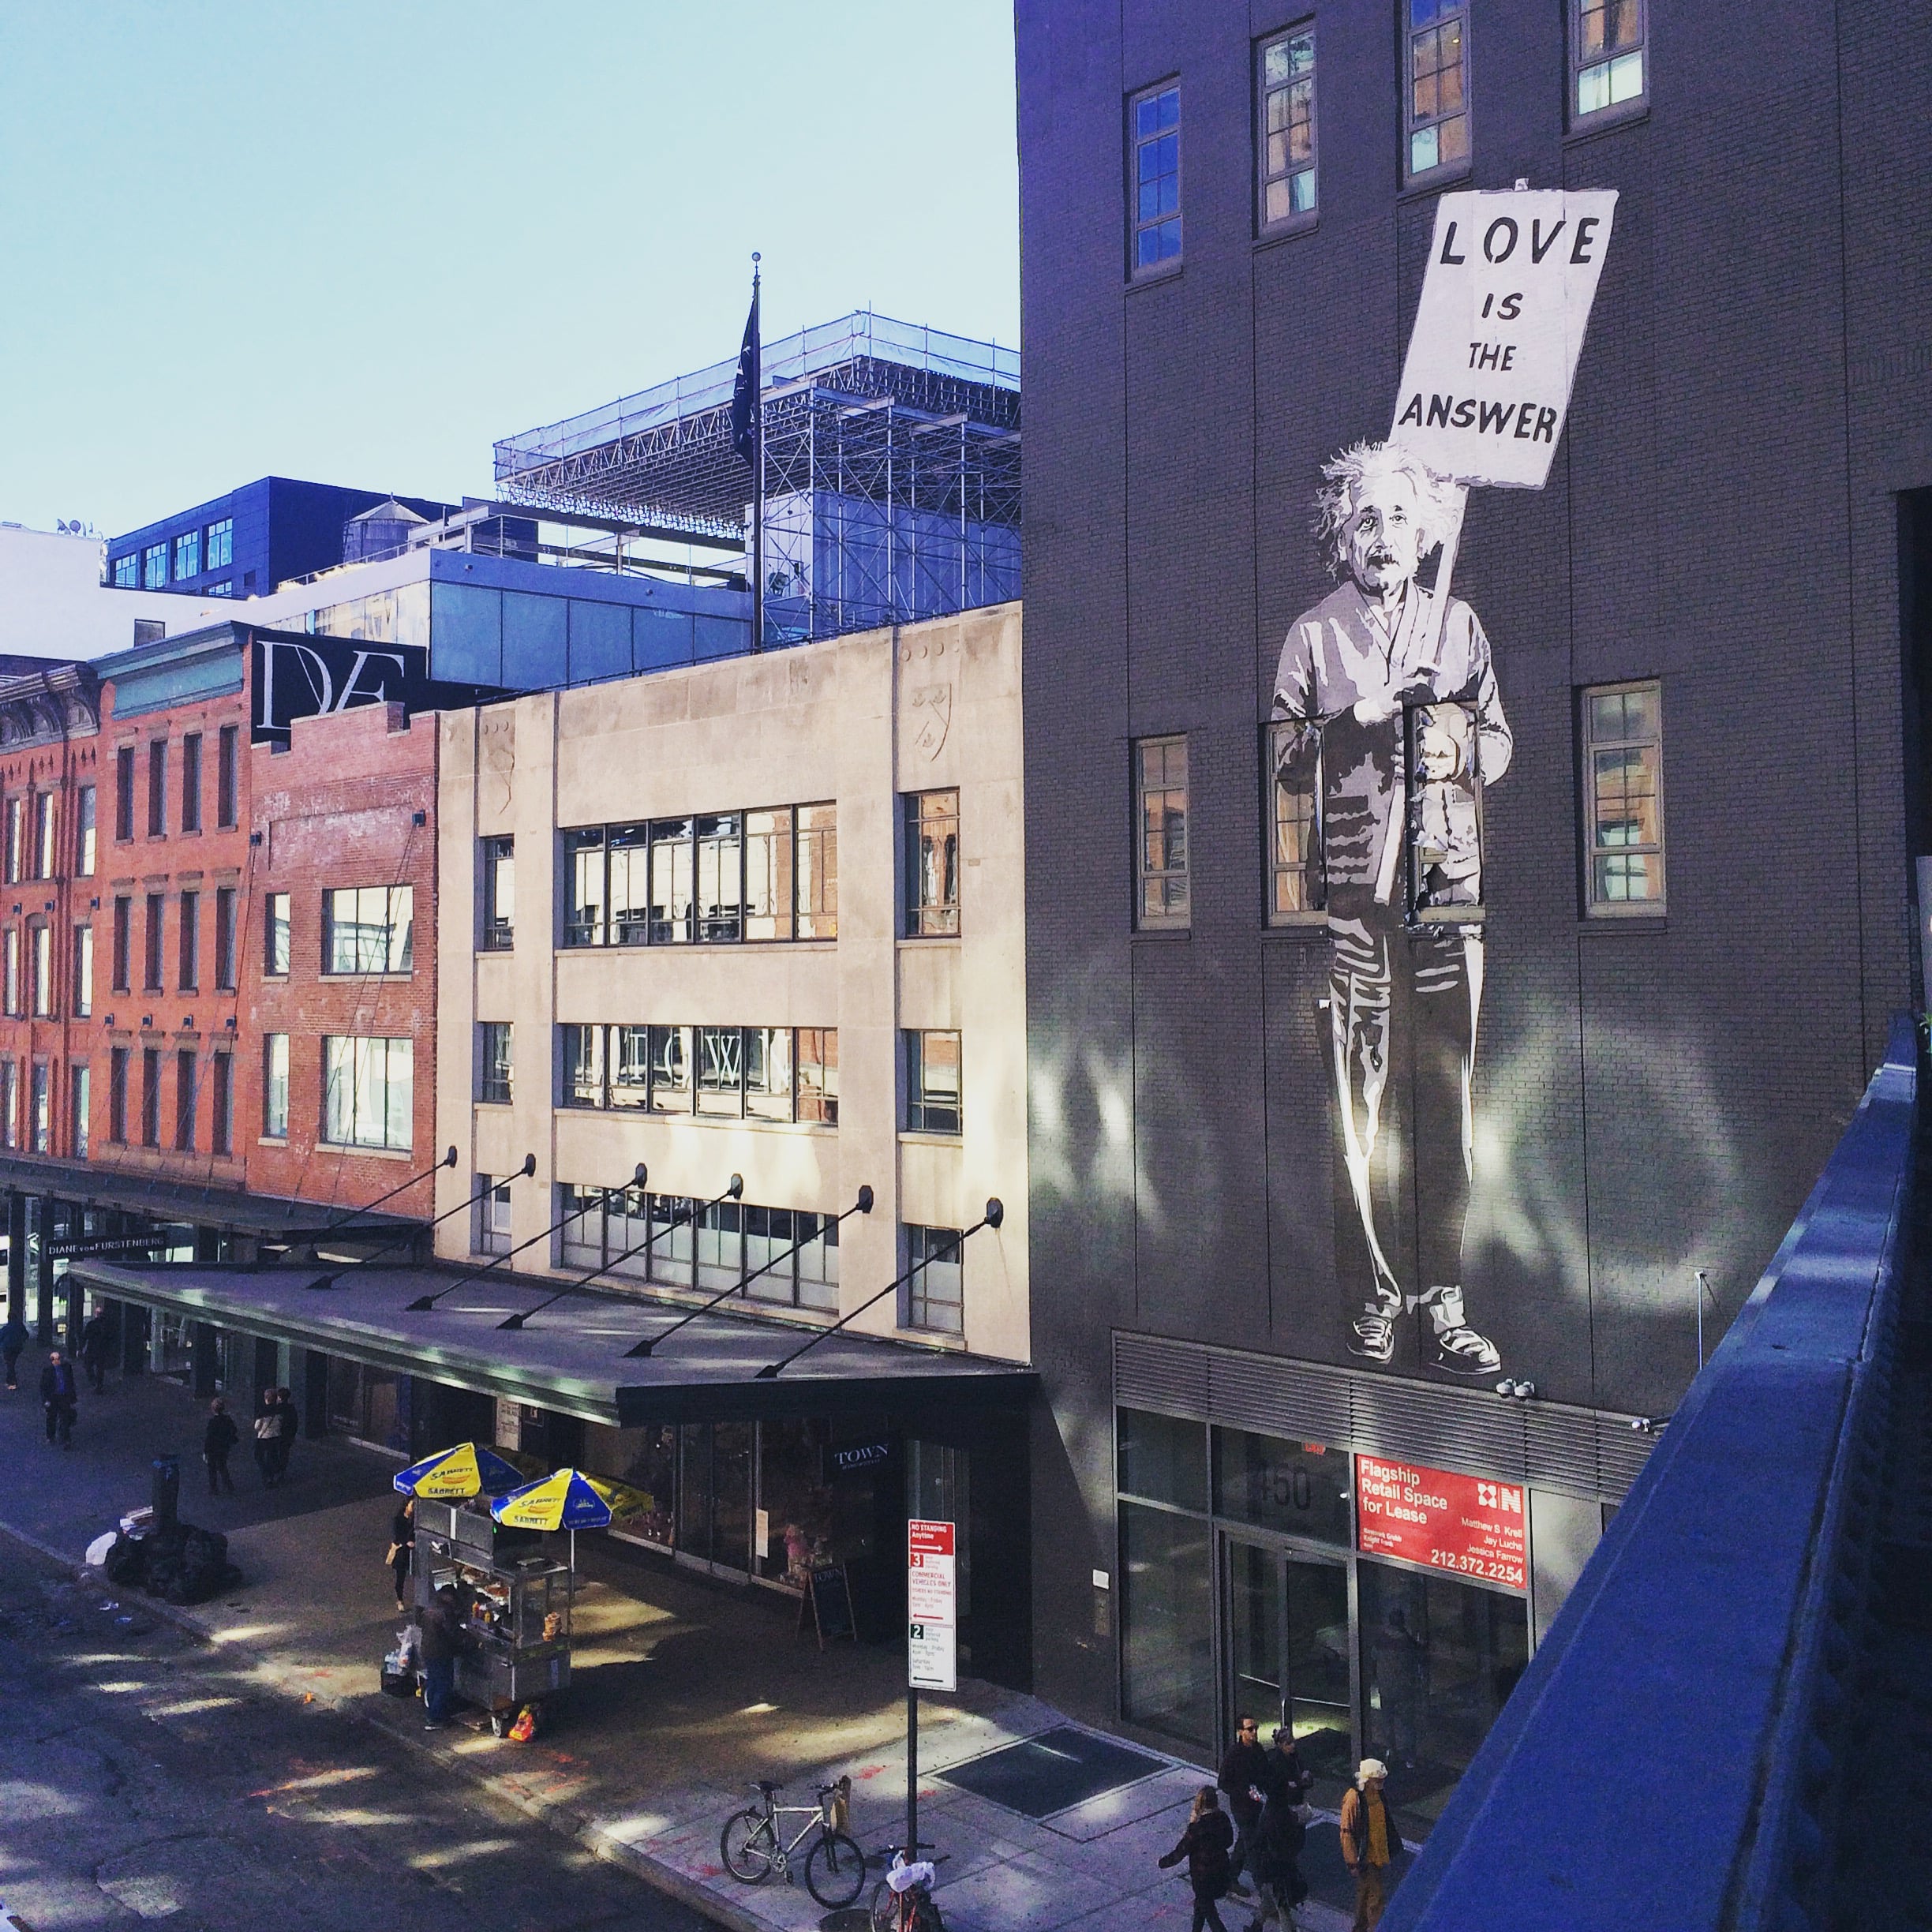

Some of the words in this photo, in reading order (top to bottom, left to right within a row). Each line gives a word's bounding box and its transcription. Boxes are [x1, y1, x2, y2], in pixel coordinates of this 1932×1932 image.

[1440, 216, 1600, 264] LOVE
[1481, 293, 1523, 320] IS
[1469, 342, 1517, 371] THE
[1398, 393, 1557, 444] ANSWER
[630, 1033, 792, 1091] TOWN
[48, 1245, 77, 1256] DIANE
[95, 1237, 164, 1251] FURSTENBERG
[834, 1443, 889, 1465] TOWN
[1361, 1459, 1420, 1486] Flagship
[1361, 1478, 1401, 1500] Retail
[1404, 1488, 1448, 1510] Space
[1363, 1498, 1382, 1514] for
[1386, 1500, 1428, 1524] Lease
[912, 1531, 934, 1540] Anytime
[920, 1524, 947, 1533] STANDING
[1461, 1517, 1493, 1532] Matthew
[1466, 1543, 1495, 1558] Jessica
[1496, 1549, 1524, 1564] Farrow
[1483, 1535, 1498, 1547] Jay
[1499, 1537, 1523, 1552] Luchs
[912, 1553, 921, 1567] 3
[1430, 1548, 1524, 1584] 212.372.2254
[912, 1571, 945, 1579] COMMERCIAL
[913, 1624, 921, 1638] 2
